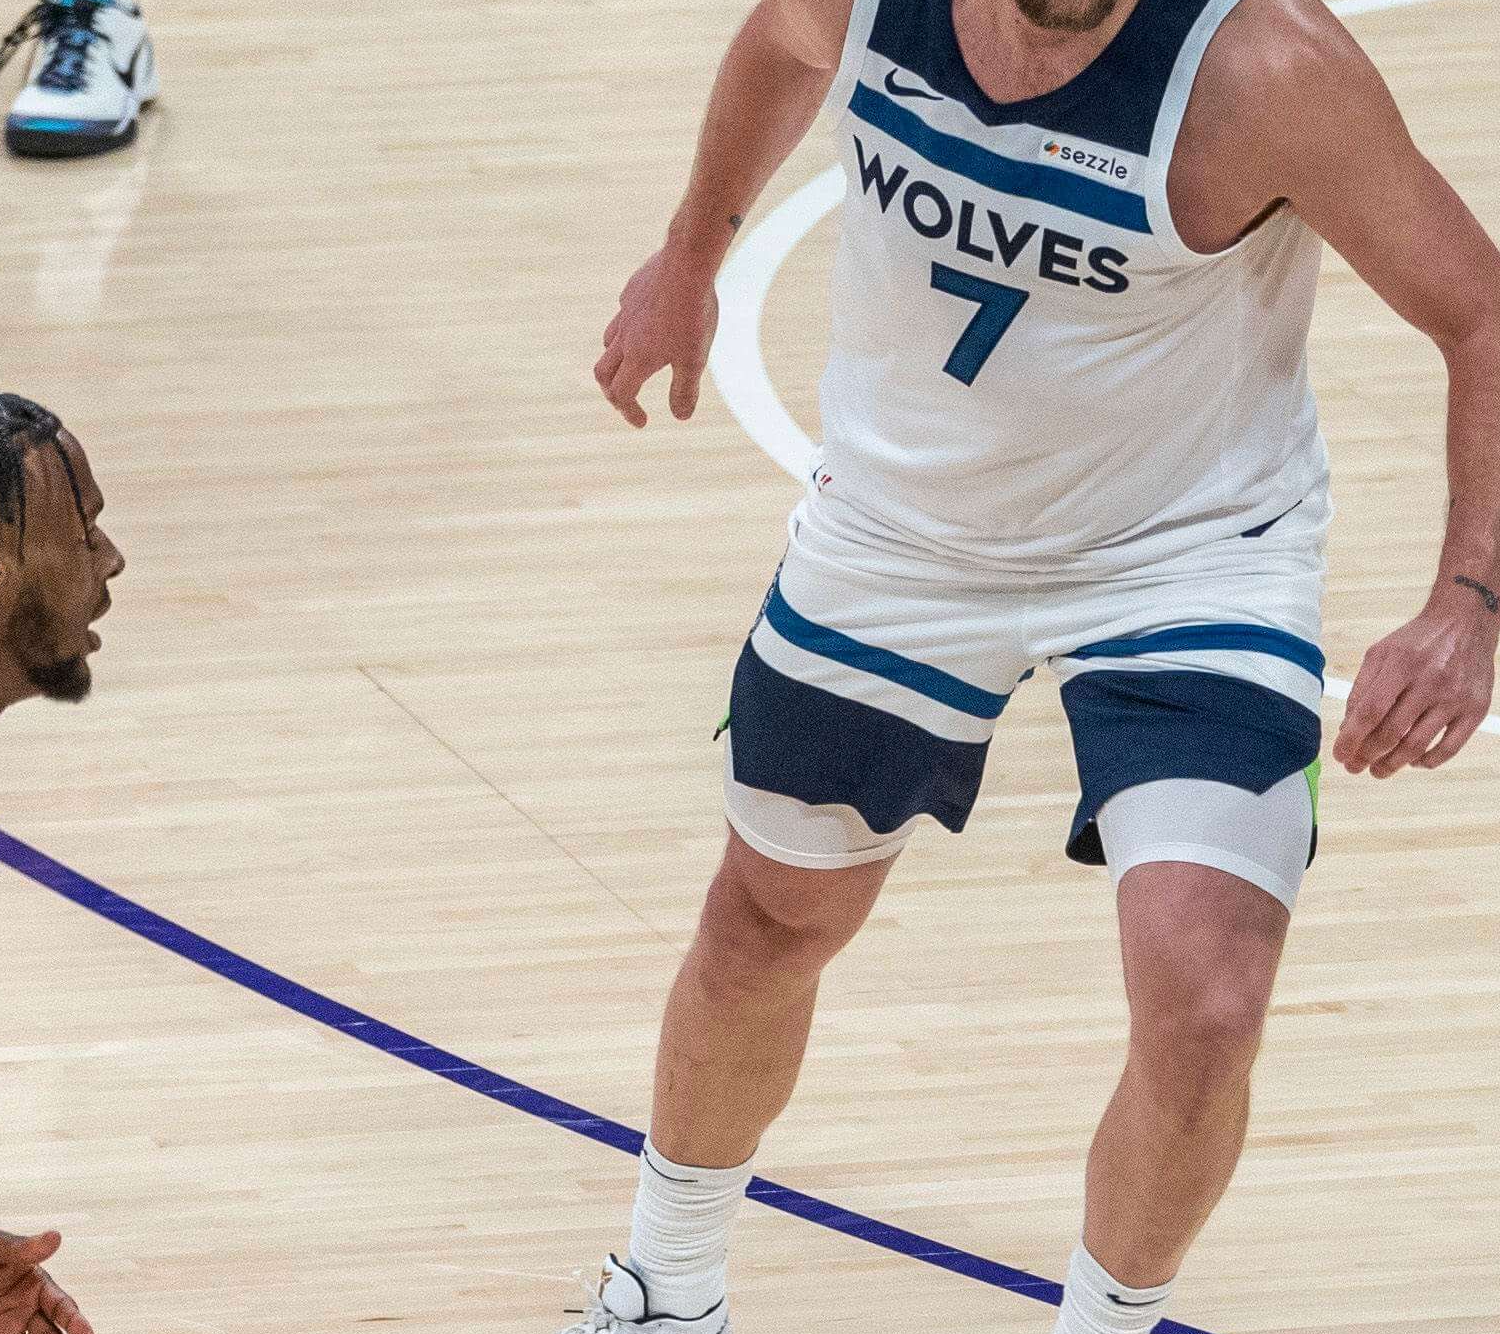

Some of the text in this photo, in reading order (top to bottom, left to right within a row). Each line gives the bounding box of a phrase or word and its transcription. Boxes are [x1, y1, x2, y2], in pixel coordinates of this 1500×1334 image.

[853, 134, 1130, 294] WOLVES
[1060, 146, 1128, 179] sezzle
[930, 261, 1030, 388] 7
